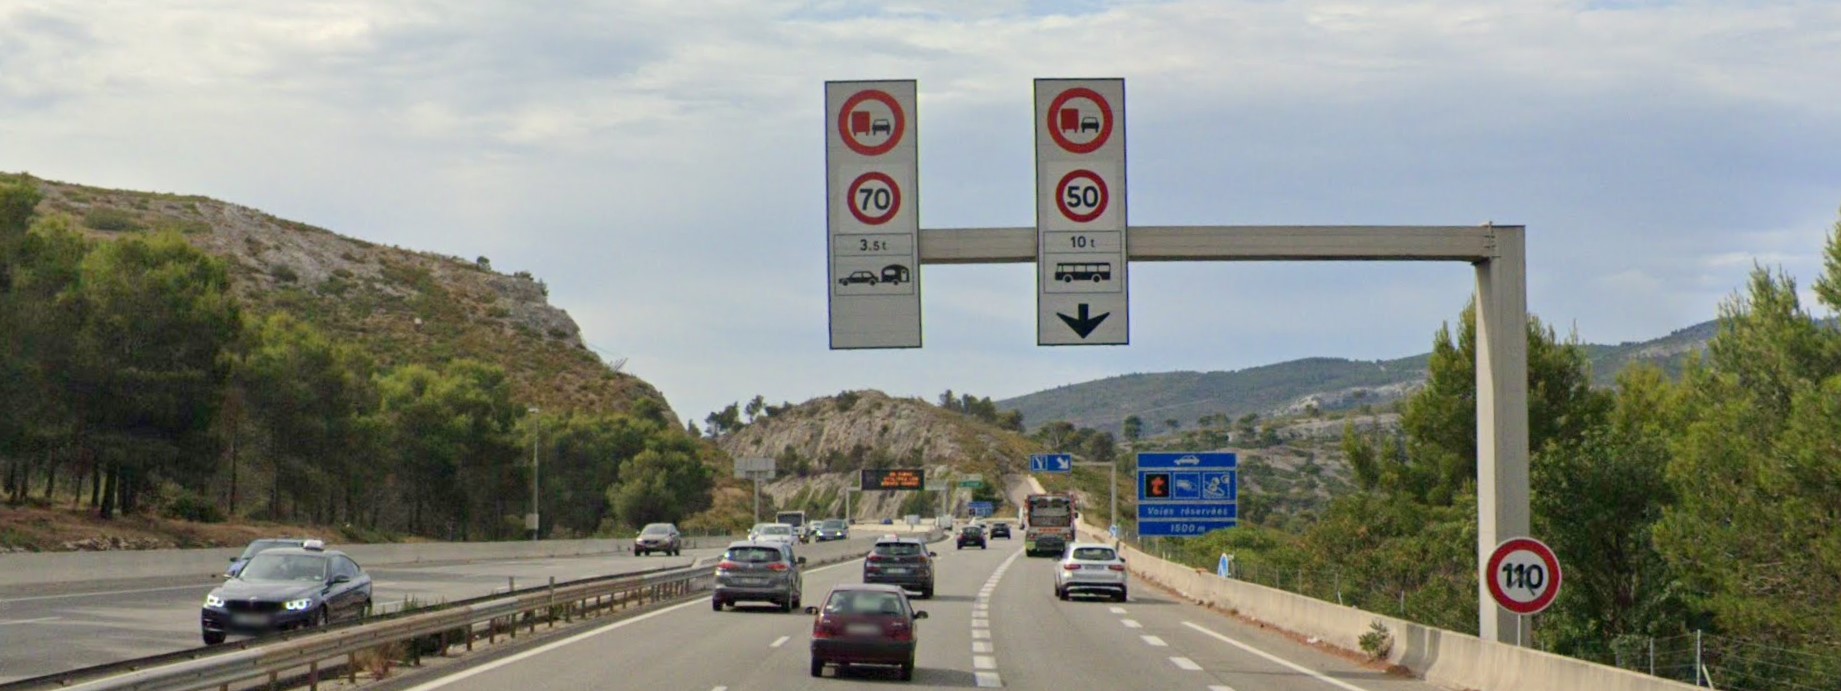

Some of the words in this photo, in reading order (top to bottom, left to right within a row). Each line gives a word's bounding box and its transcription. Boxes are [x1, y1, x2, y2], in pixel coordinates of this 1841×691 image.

[859, 188, 890, 211] 70
[1066, 186, 1098, 208] 50
[1070, 236, 1086, 247] 10
[1147, 507, 1174, 516] Voies
[1180, 507, 1228, 516] réservées
[1170, 524, 1195, 533] 1500
[1197, 525, 1206, 533] m
[1502, 563, 1544, 589] 110
